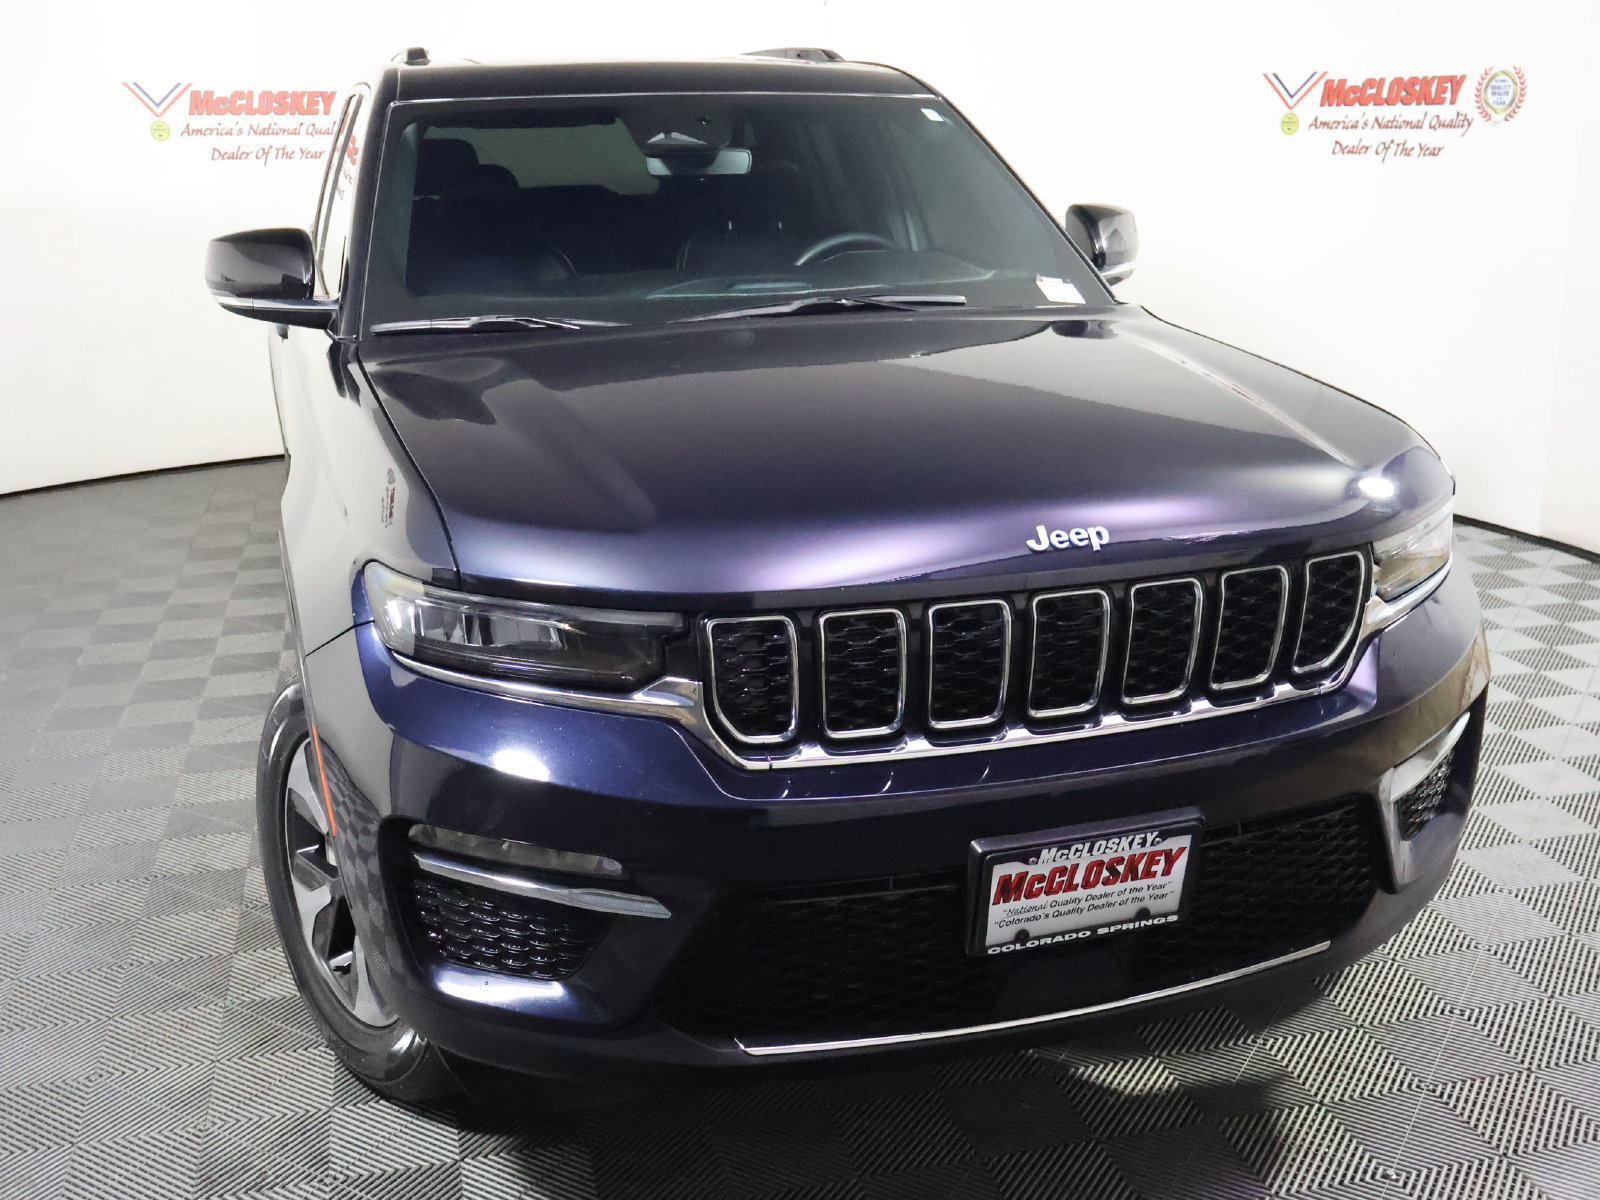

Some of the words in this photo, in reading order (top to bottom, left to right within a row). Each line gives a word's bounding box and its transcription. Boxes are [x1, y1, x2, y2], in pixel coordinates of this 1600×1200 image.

[188, 90, 337, 116] McCLOSKEY
[1319, 74, 1467, 107] McCLOSKEY
[180, 121, 244, 137] America's
[248, 122, 303, 137] National
[305, 121, 337, 138] Qual
[1308, 111, 1368, 131] America's
[1371, 112, 1428, 130] National
[1429, 111, 1475, 137] Quality
[211, 146, 253, 161] Dealer
[255, 146, 271, 167] Of
[270, 144, 296, 160] The
[299, 147, 326, 161] Year
[1331, 138, 1372, 156] Dealer
[1375, 139, 1395, 164] Of
[1393, 140, 1415, 157] The
[1415, 142, 1445, 158] Year
[1026, 525, 1110, 552] Jeep
[1037, 831, 1159, 865] McCLOSKEY
[992, 847, 1187, 906] McCLOSKEY
[1049, 896, 1083, 909] Quality
[1085, 891, 1115, 902] Dealer
[1117, 888, 1128, 897] of
[1129, 885, 1144, 894] the
[1052, 906, 1085, 919] Quality
[1087, 900, 1118, 912] Dealer
[1119, 897, 1129, 906] of
[1131, 894, 1146, 904] the
[988, 930, 1091, 954] COLORADO
[1097, 914, 1179, 935] SPRINGS
